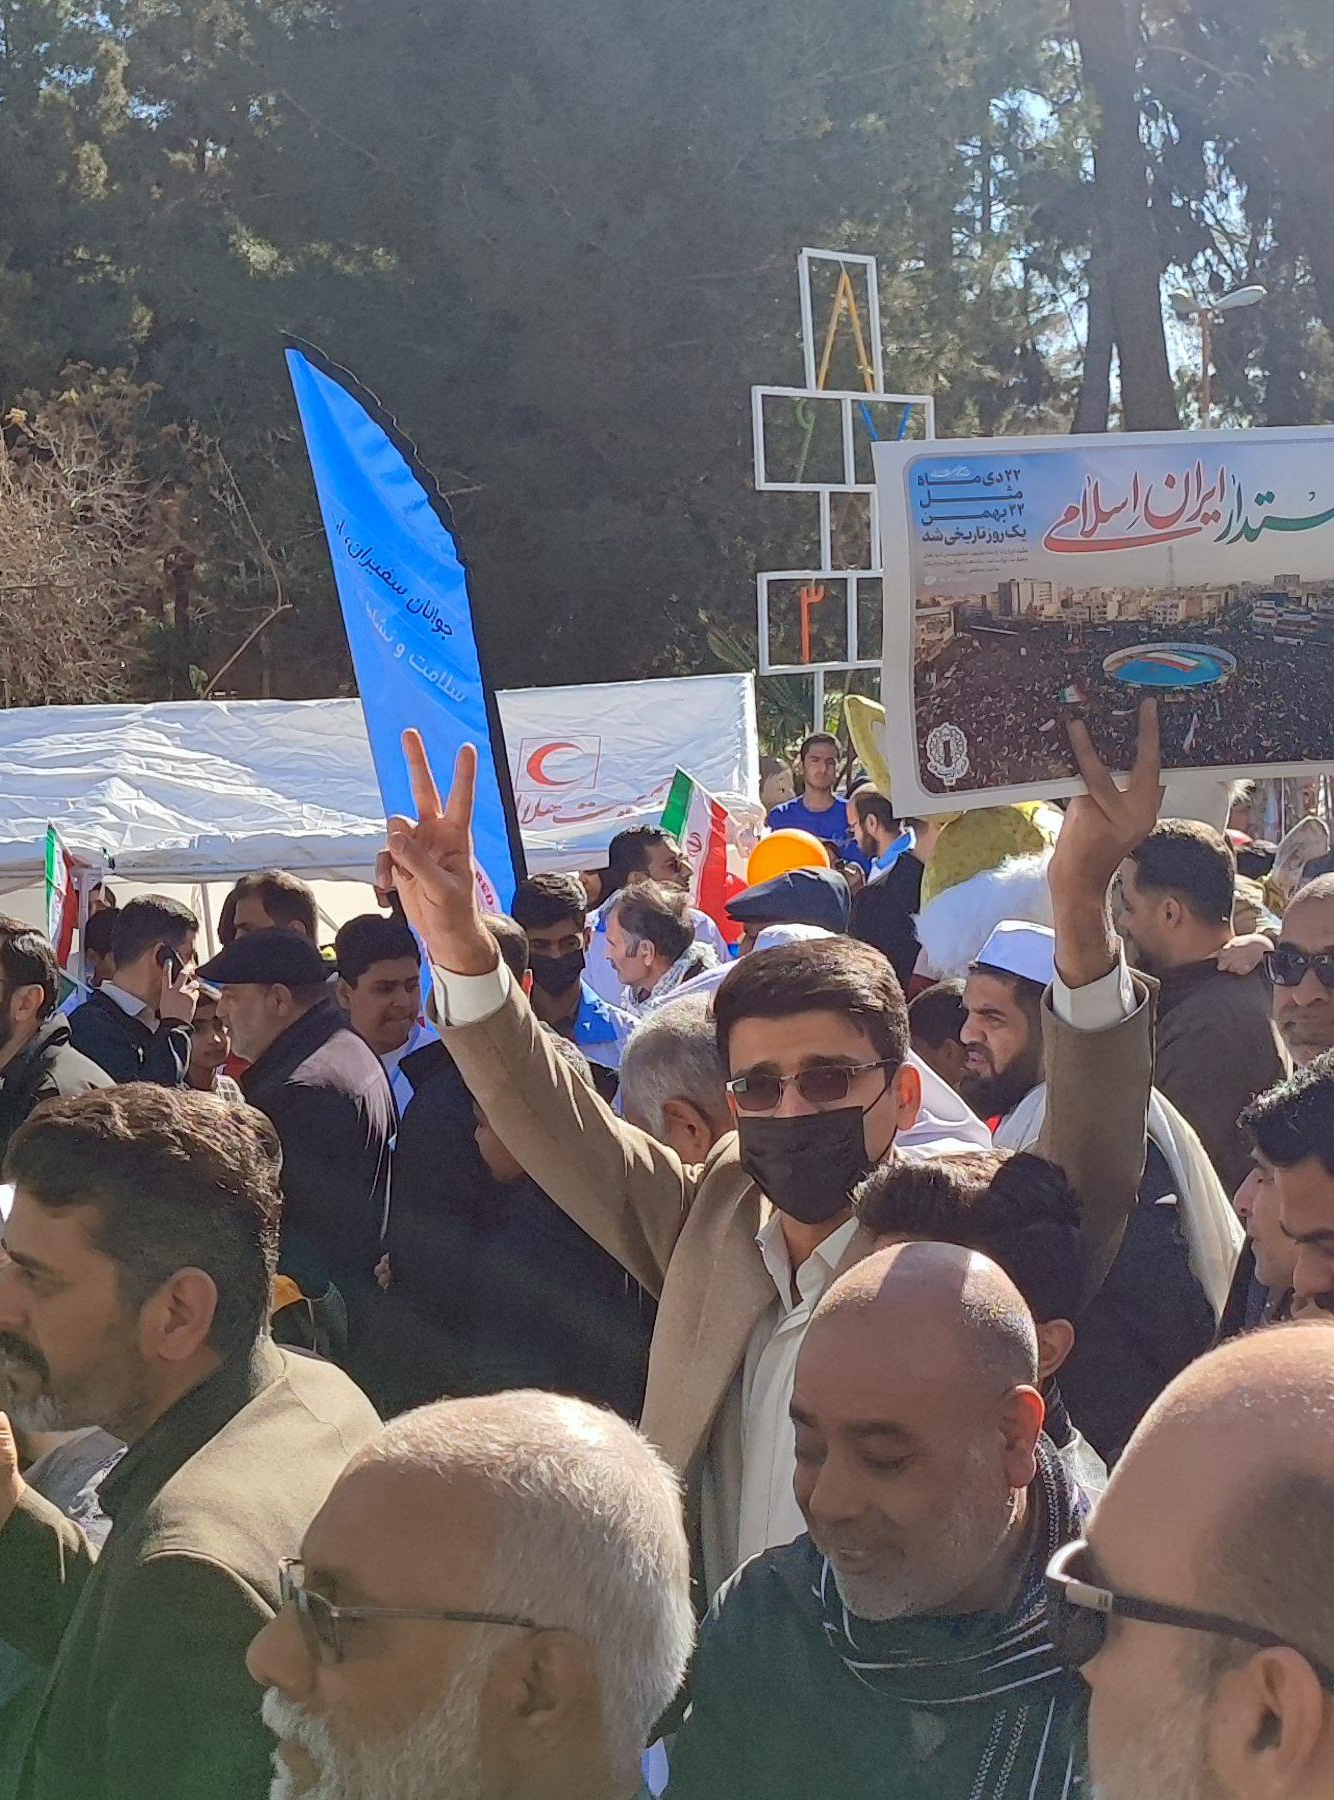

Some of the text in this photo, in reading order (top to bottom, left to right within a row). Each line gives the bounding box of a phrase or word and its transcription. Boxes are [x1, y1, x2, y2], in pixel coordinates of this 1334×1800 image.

[917, 473, 982, 487] ماه
[919, 485, 1024, 509] مثل
[1143, 459, 1228, 530] ایران
[921, 507, 1008, 526] بهمن
[1043, 468, 1203, 553] اسلامی
[921, 527, 944, 542] شد
[944, 526, 987, 546] تاریخی
[987, 530, 1005, 544] روز
